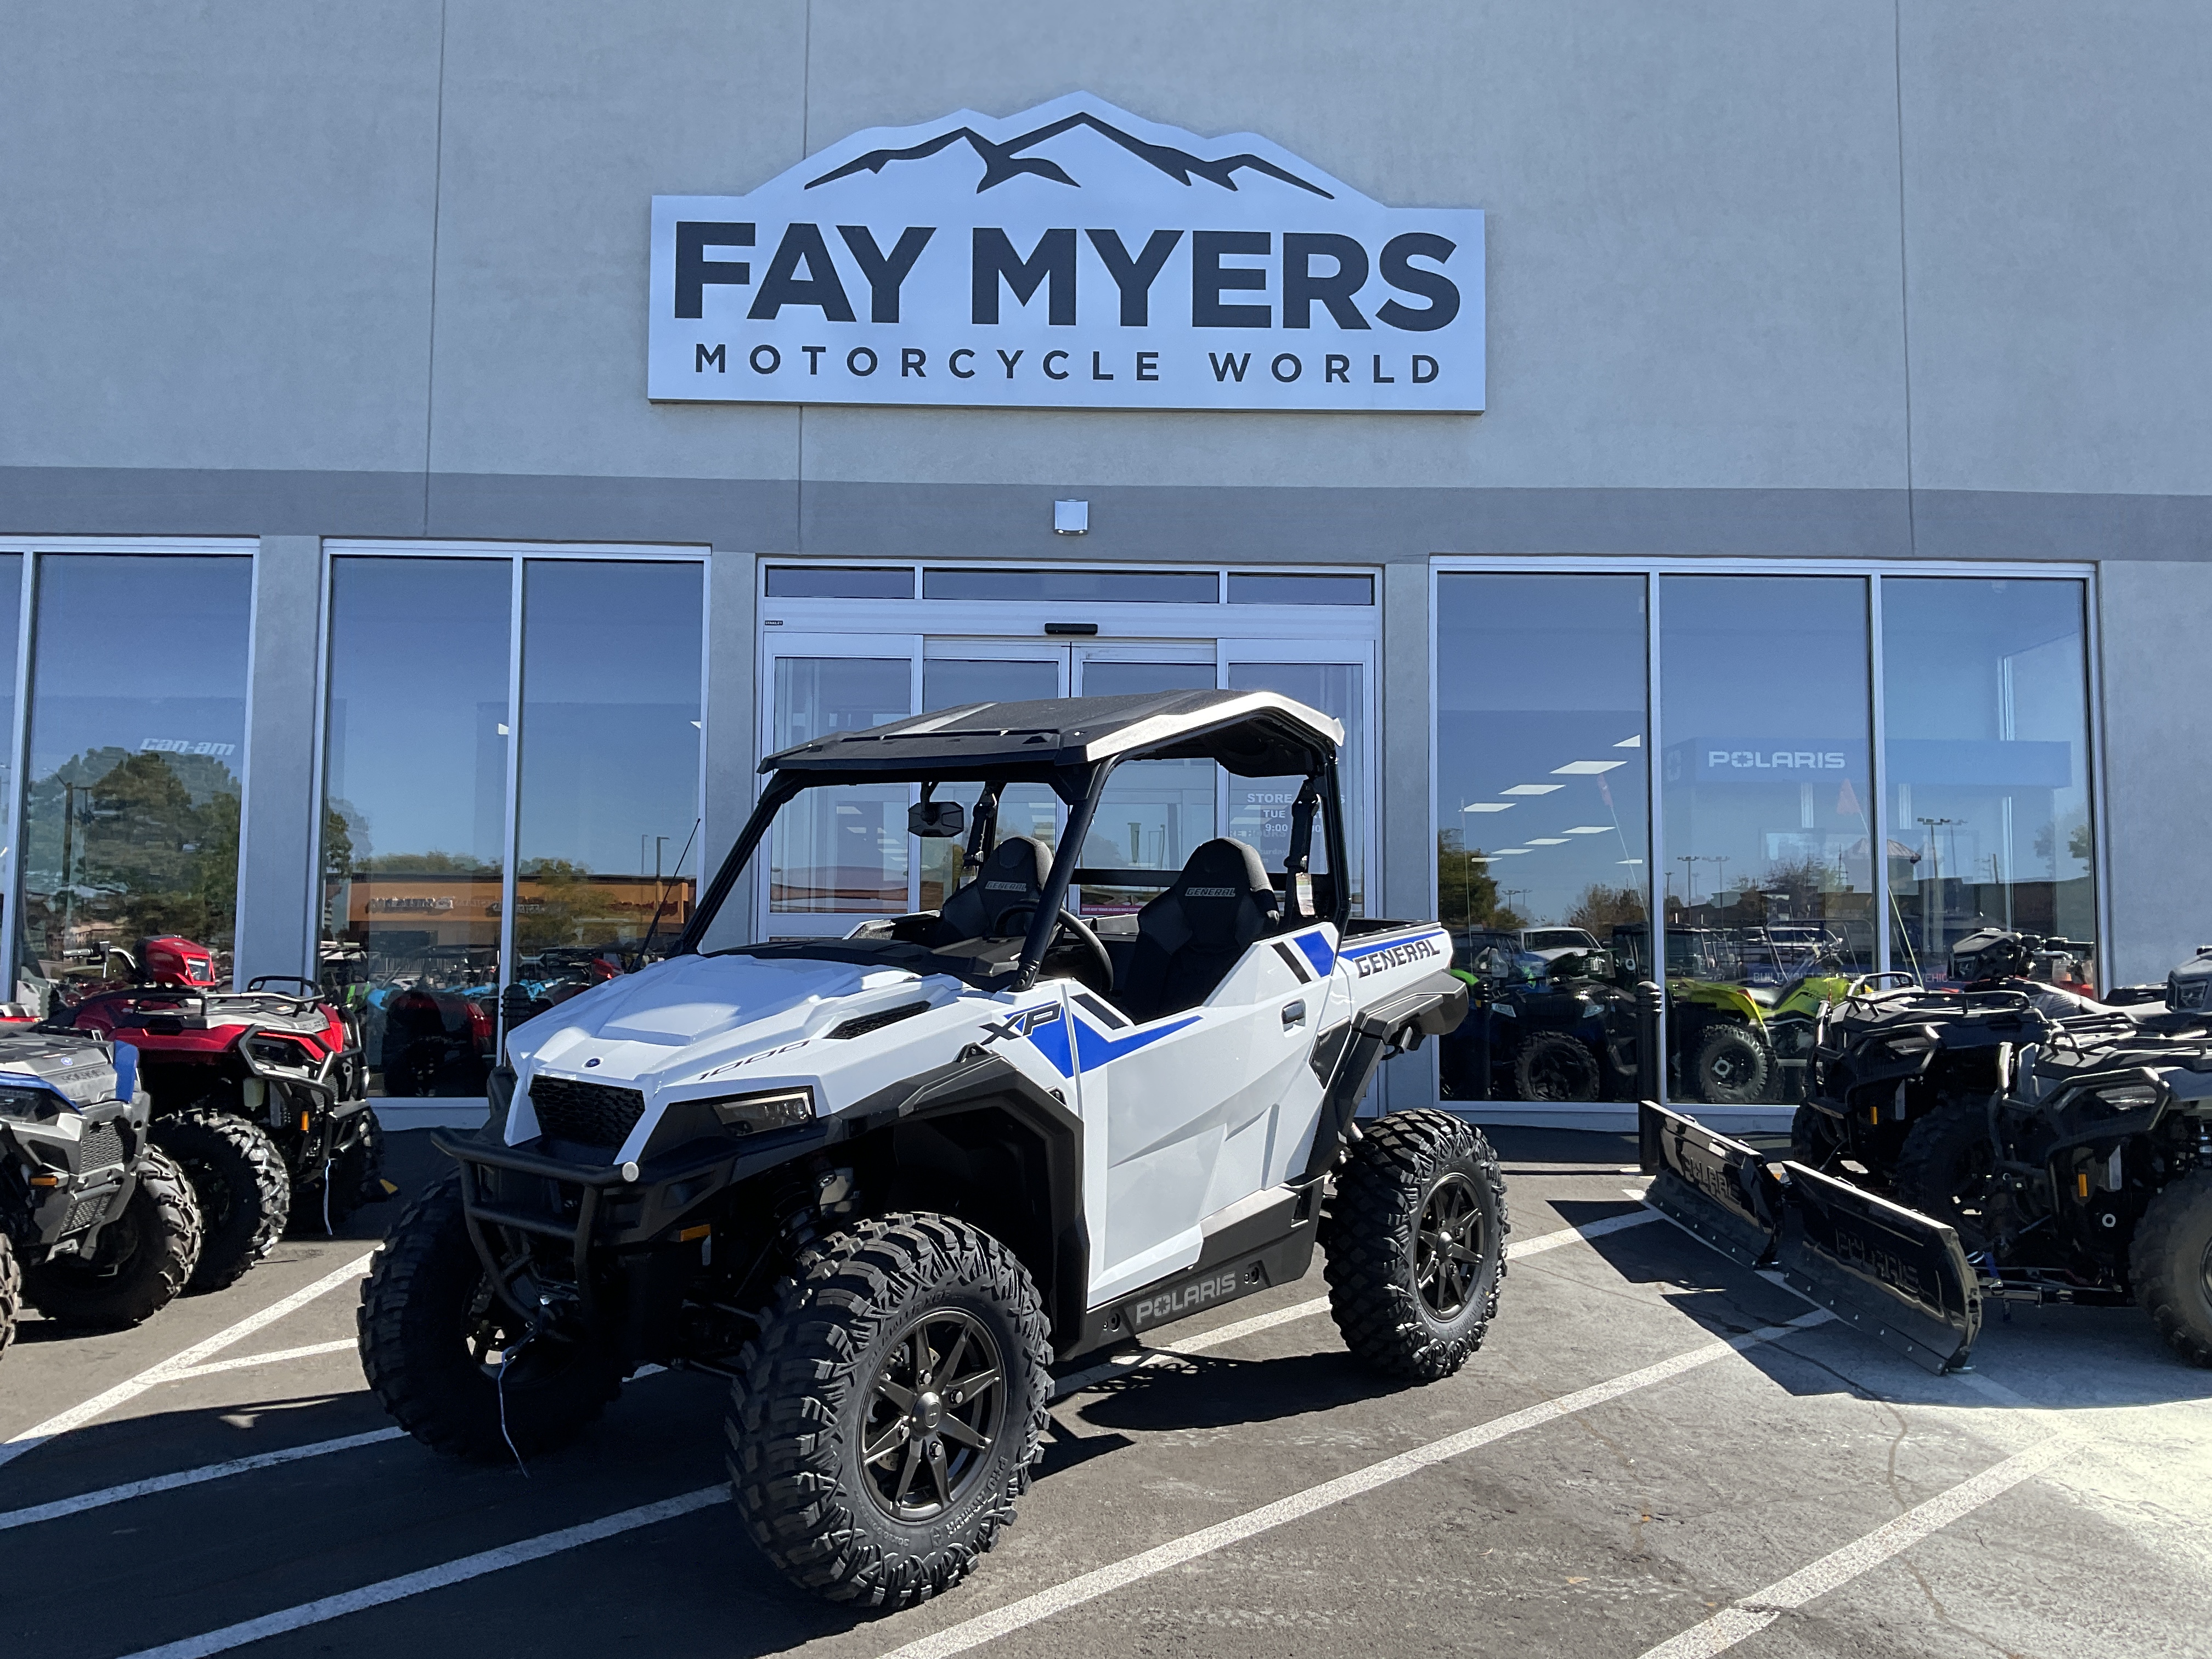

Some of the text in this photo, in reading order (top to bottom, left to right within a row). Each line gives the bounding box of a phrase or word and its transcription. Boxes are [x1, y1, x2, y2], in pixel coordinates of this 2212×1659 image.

[675, 221, 1460, 332] FAY MYERS
[695, 343, 1439, 383] MOTORCYCLE WORLD
[1708, 751, 1846, 769] POLARIS
[1247, 793, 1292, 803] STORE
[1263, 810, 1286, 818] TUE
[1265, 823, 1288, 832] 9:00
[986, 881, 1026, 891] GENERAL
[1186, 888, 1235, 896] GENERAL
[1353, 939, 1441, 979] GENERAL
[979, 1002, 1062, 1046] XP
[698, 1040, 810, 1081] 1000
[1136, 1273, 1236, 1324] POLARIS
